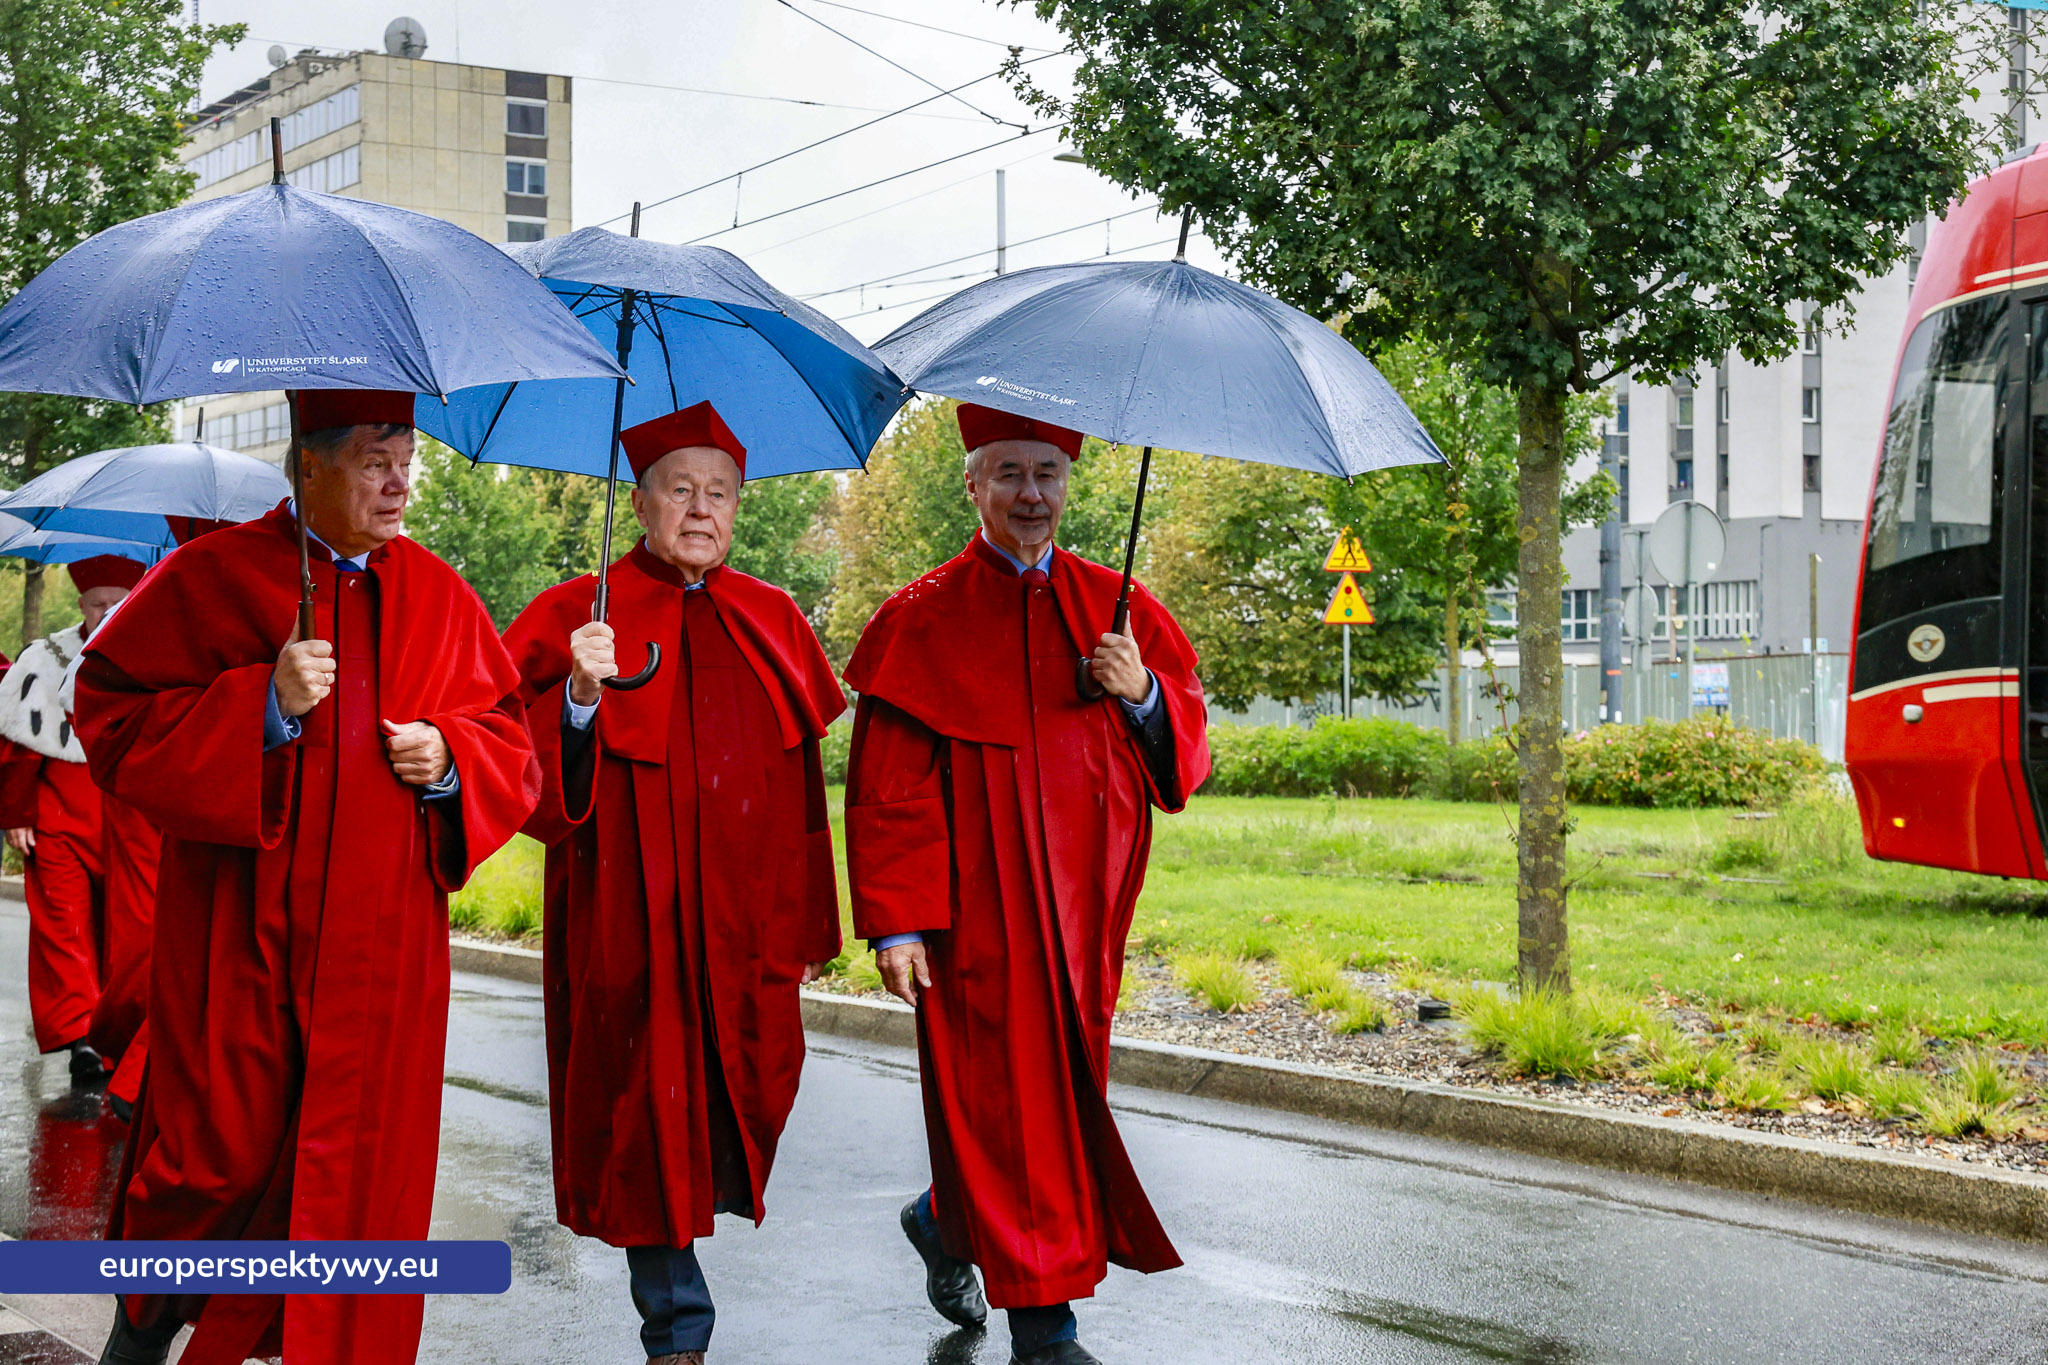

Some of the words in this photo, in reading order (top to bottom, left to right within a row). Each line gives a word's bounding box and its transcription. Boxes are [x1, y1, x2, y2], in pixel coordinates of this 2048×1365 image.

[247, 356, 327, 366] UNIWERSYTET
[328, 355, 367, 366] ŚLĄSKI
[1000, 380, 1051, 400] UNIWERSYTET
[1049, 394, 1076, 406] ŚLĄSKI
[1001, 389, 1033, 402] KATOWICACH
